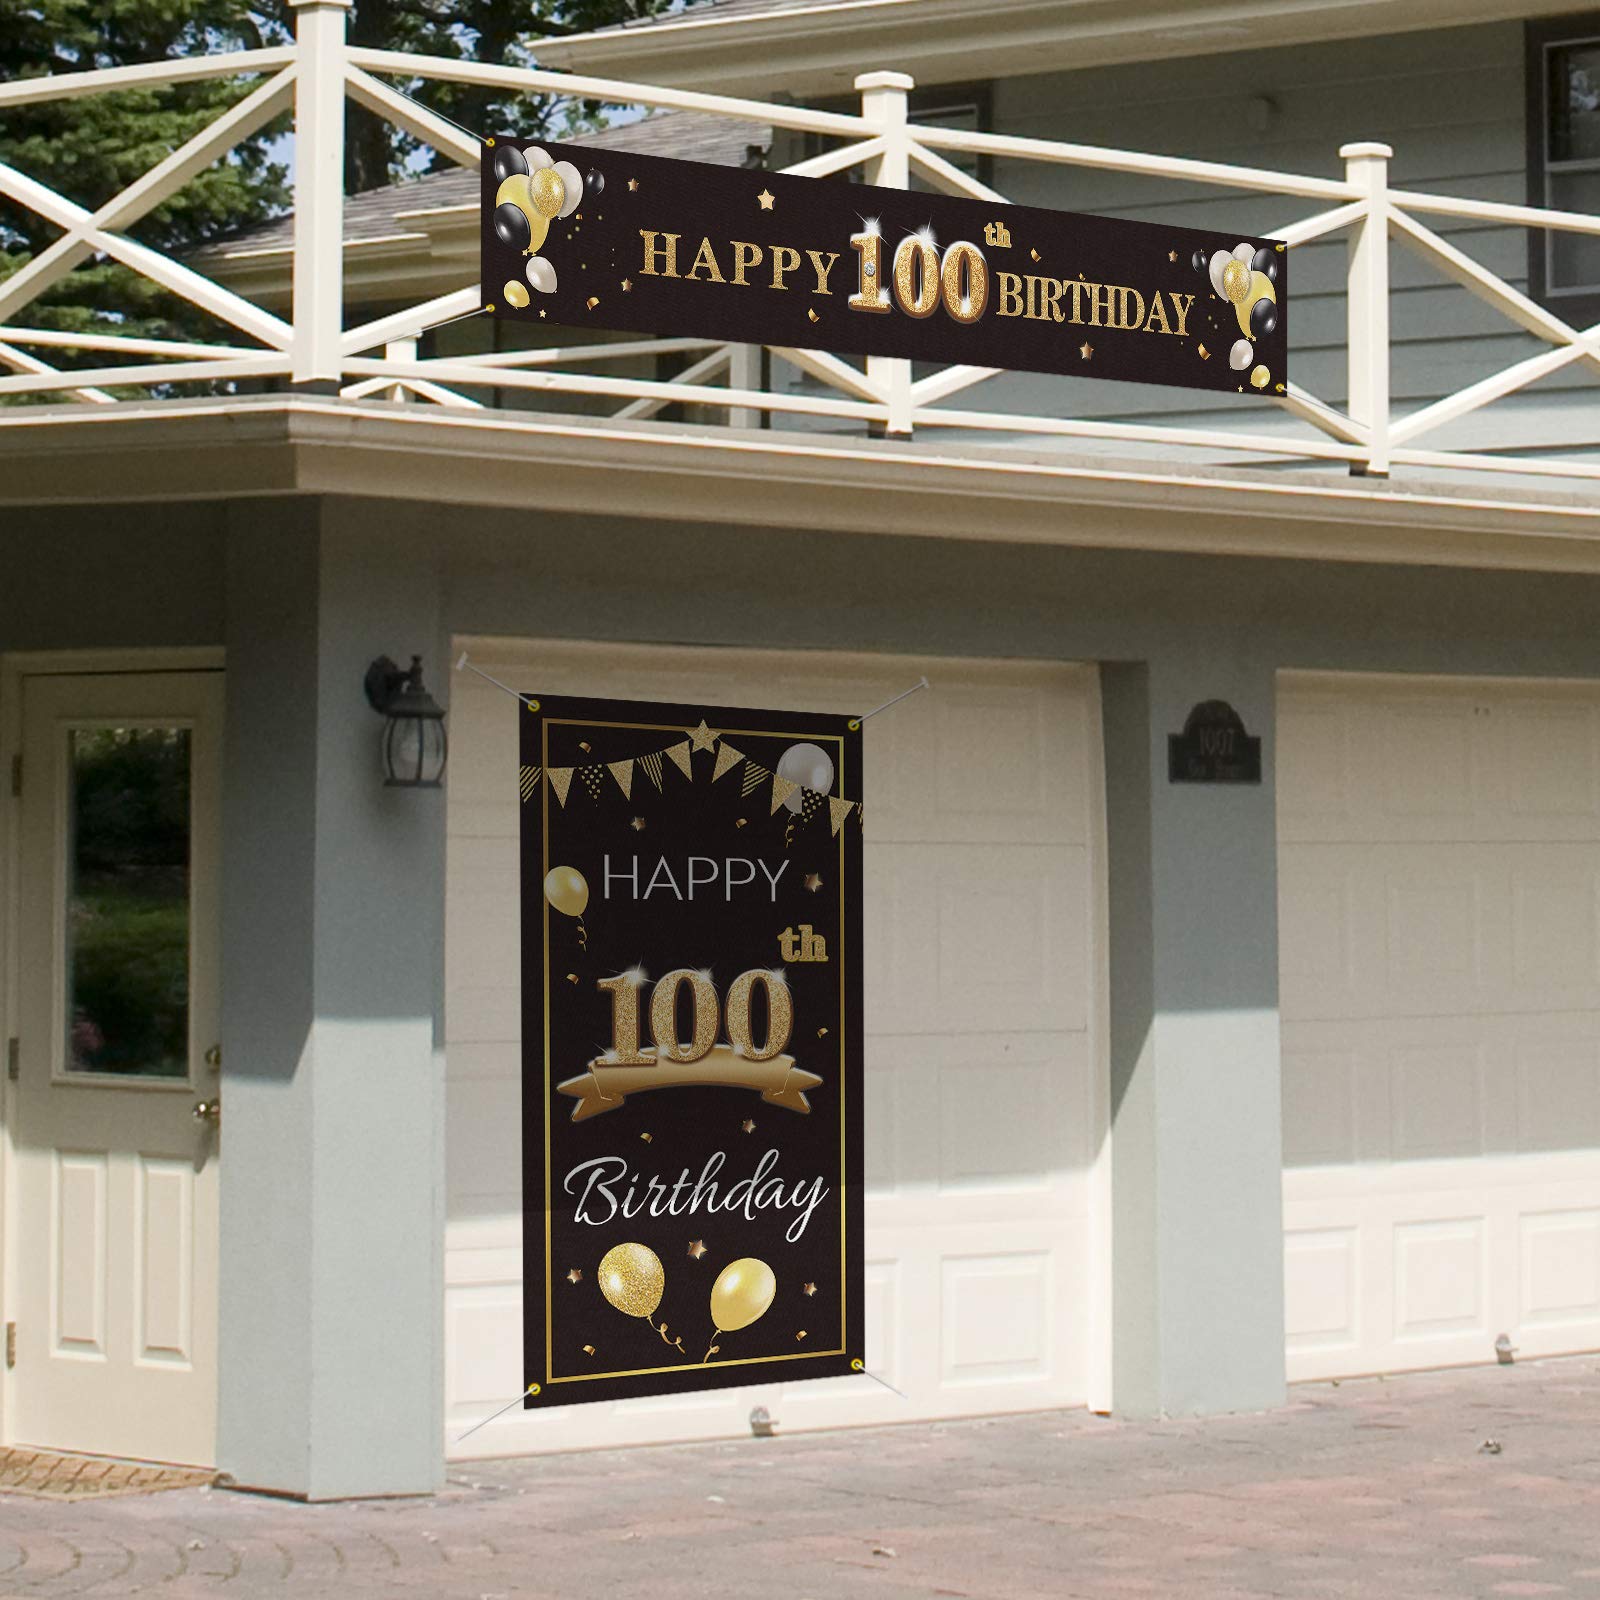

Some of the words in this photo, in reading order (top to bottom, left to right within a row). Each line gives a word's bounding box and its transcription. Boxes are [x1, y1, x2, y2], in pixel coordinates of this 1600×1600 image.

[639, 228, 841, 296] HAPPY
[848, 231, 989, 323] 100
[995, 271, 1196, 337] BIRTHDAY
[603, 854, 790, 902] HAPPY
[776, 924, 829, 963] th
[597, 967, 794, 1067] 100
[563, 1148, 830, 1243] Birthday
